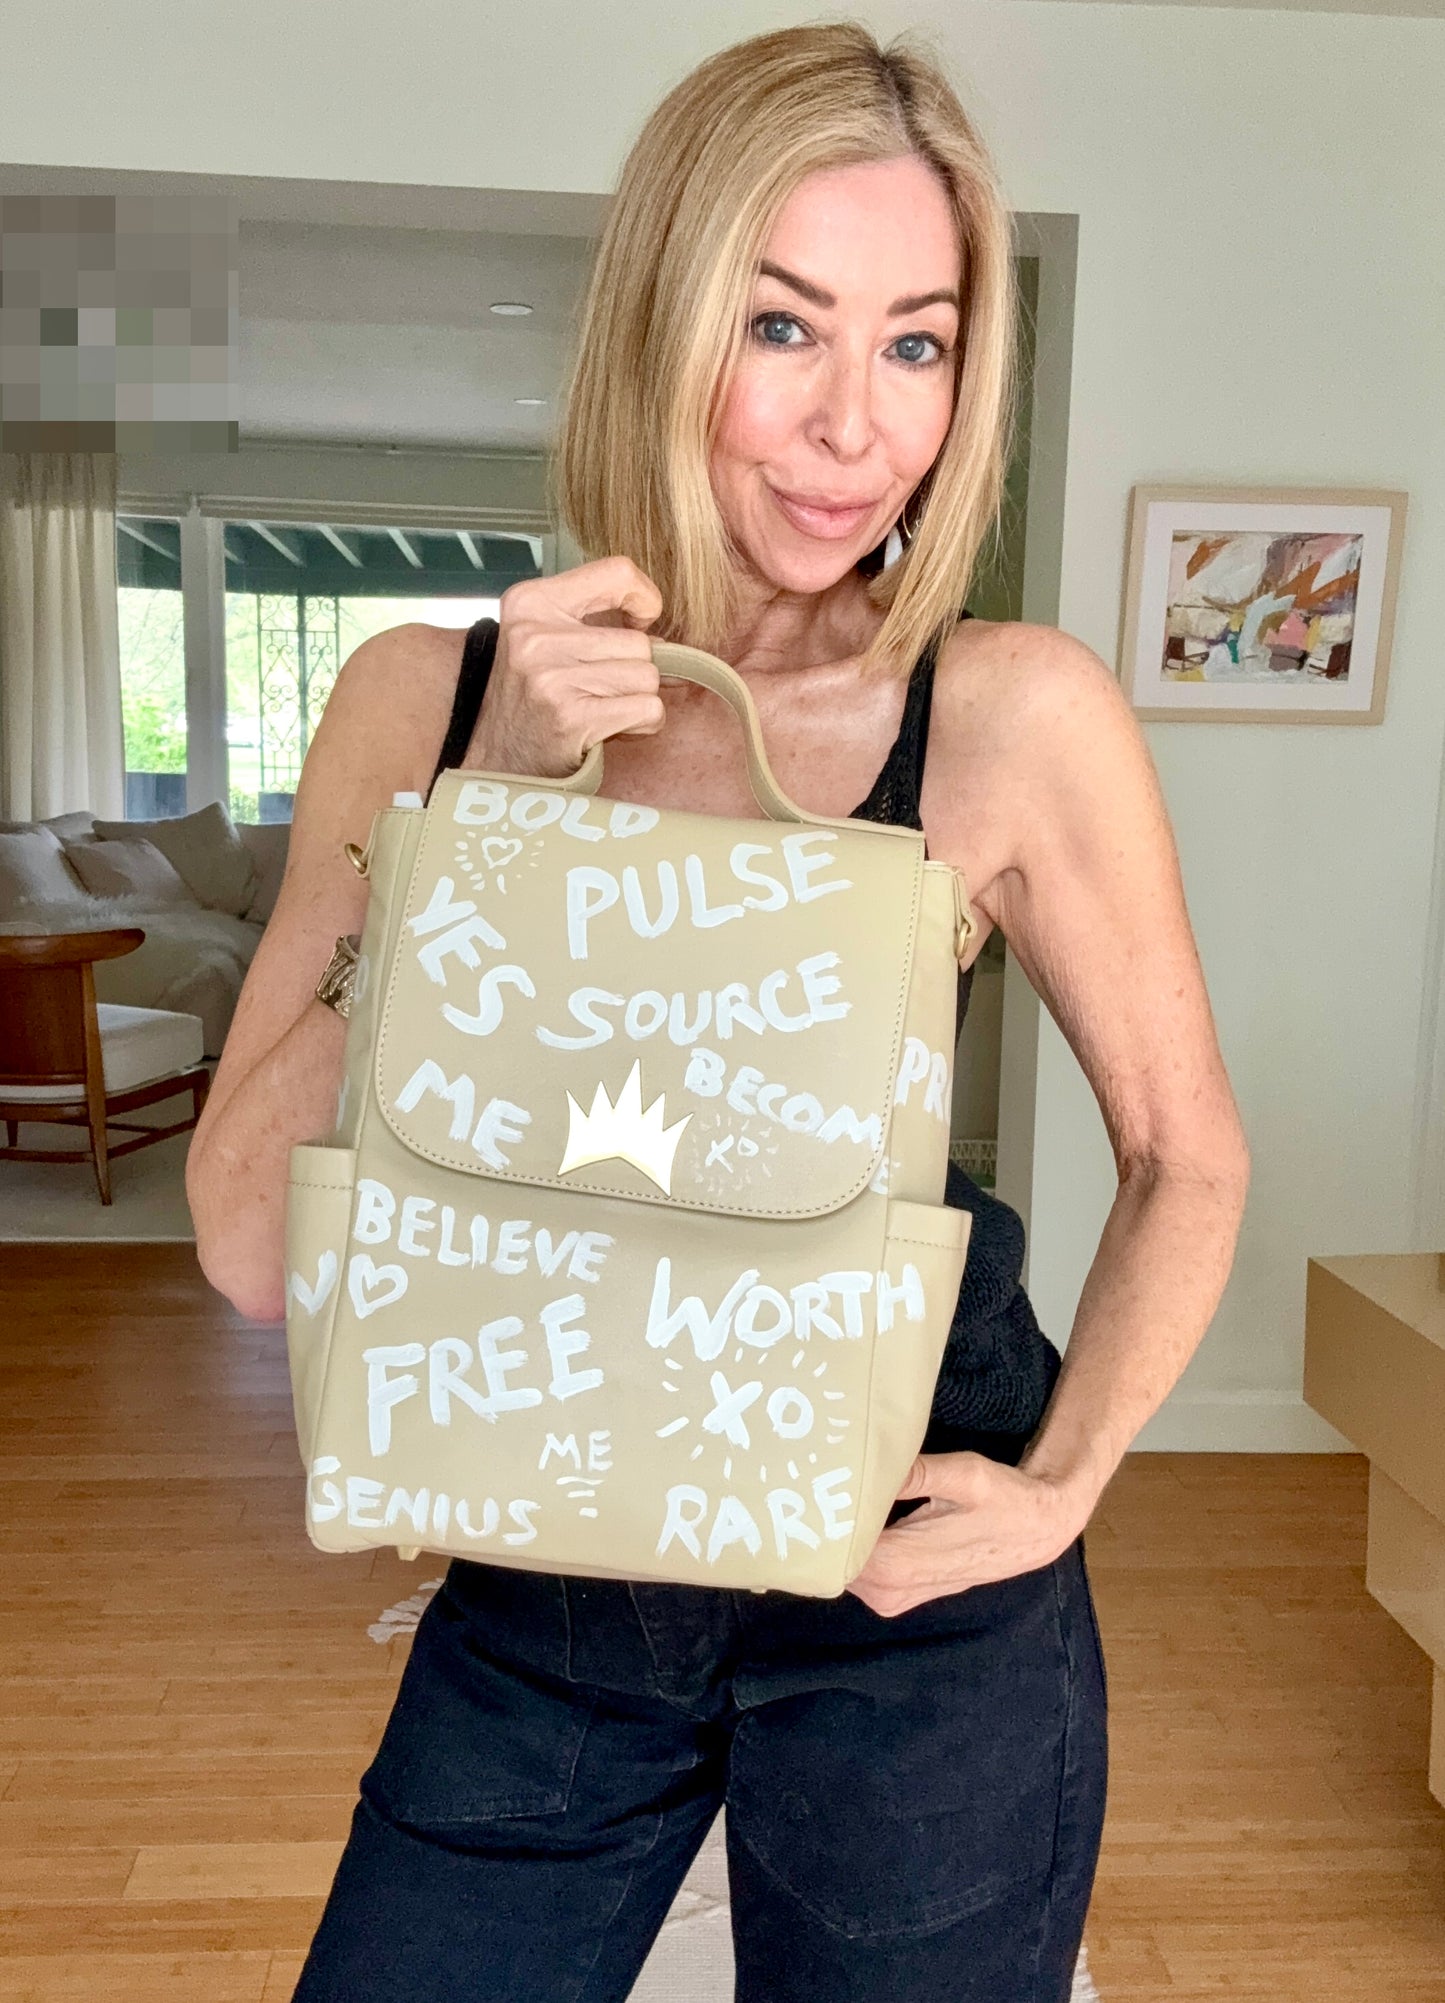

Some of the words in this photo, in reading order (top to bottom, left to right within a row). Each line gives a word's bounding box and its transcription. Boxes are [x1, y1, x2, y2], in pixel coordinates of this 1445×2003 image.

[453, 780, 660, 842] BOLD
[566, 830, 855, 960] PULSE
[407, 875, 537, 1036] YES
[535, 951, 853, 1050] SOURCE
[394, 1059, 533, 1169] ME
[353, 1178, 615, 1283] BELIEVE
[645, 1257, 926, 1361] WORTH
[361, 1293, 605, 1457] FREE
[702, 1370, 814, 1450] XO
[538, 1429, 613, 1472] ME
[656, 1466, 856, 1563] RARE
